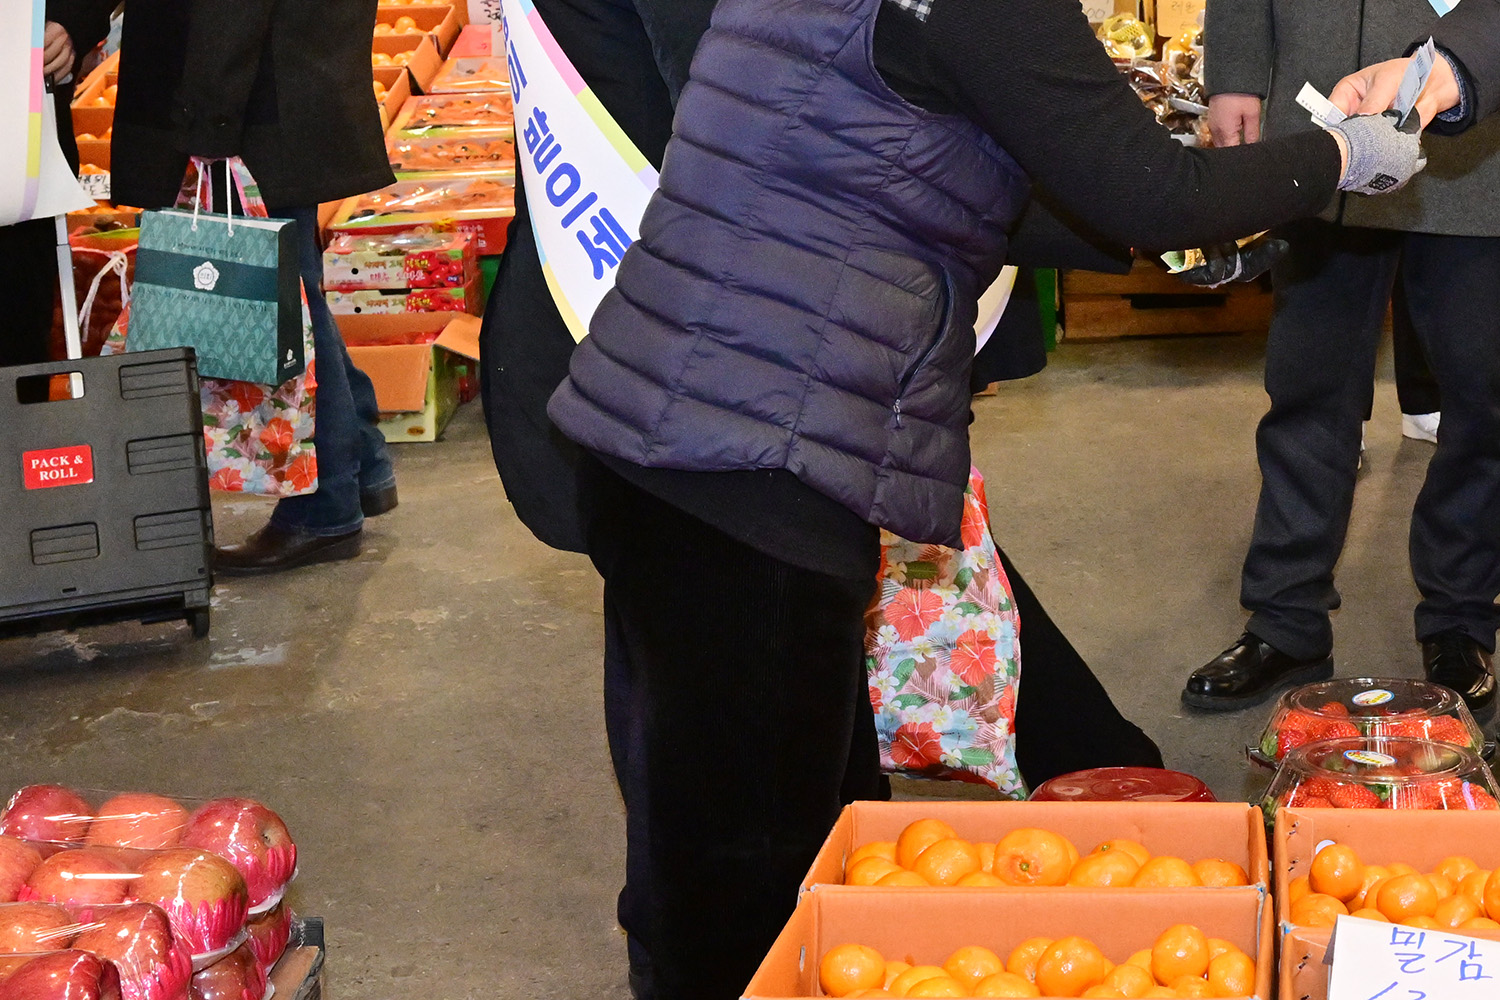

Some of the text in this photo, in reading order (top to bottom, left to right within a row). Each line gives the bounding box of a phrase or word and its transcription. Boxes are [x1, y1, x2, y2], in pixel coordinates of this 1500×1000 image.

[31, 455, 83, 469] PACK &
[40, 468, 78, 480] ROLL
[1390, 926, 1493, 981] 밀감
